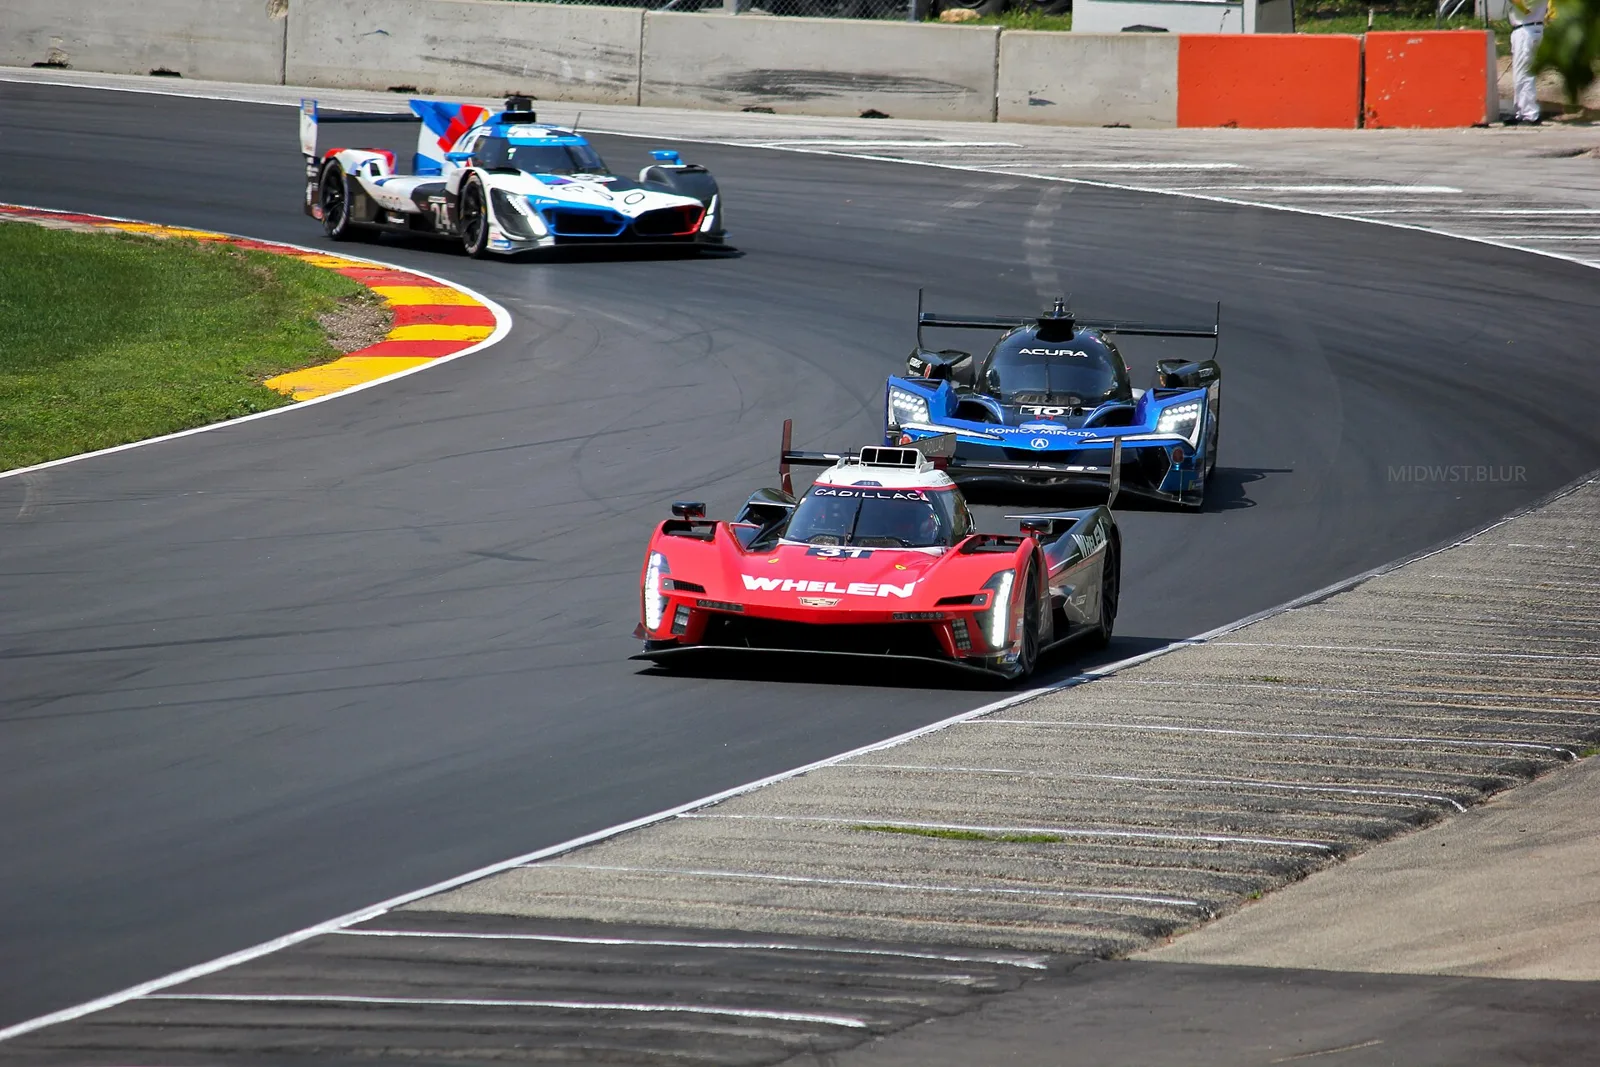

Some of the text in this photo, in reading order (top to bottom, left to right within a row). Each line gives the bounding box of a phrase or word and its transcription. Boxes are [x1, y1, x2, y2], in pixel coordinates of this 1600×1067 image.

[1018, 348, 1088, 358] ACURA
[1027, 406, 1065, 416] 10
[1039, 429, 1099, 438] MINOLTA
[814, 488, 921, 501] CADILLAC
[815, 547, 863, 558] 31
[741, 573, 917, 599] WHELEN
